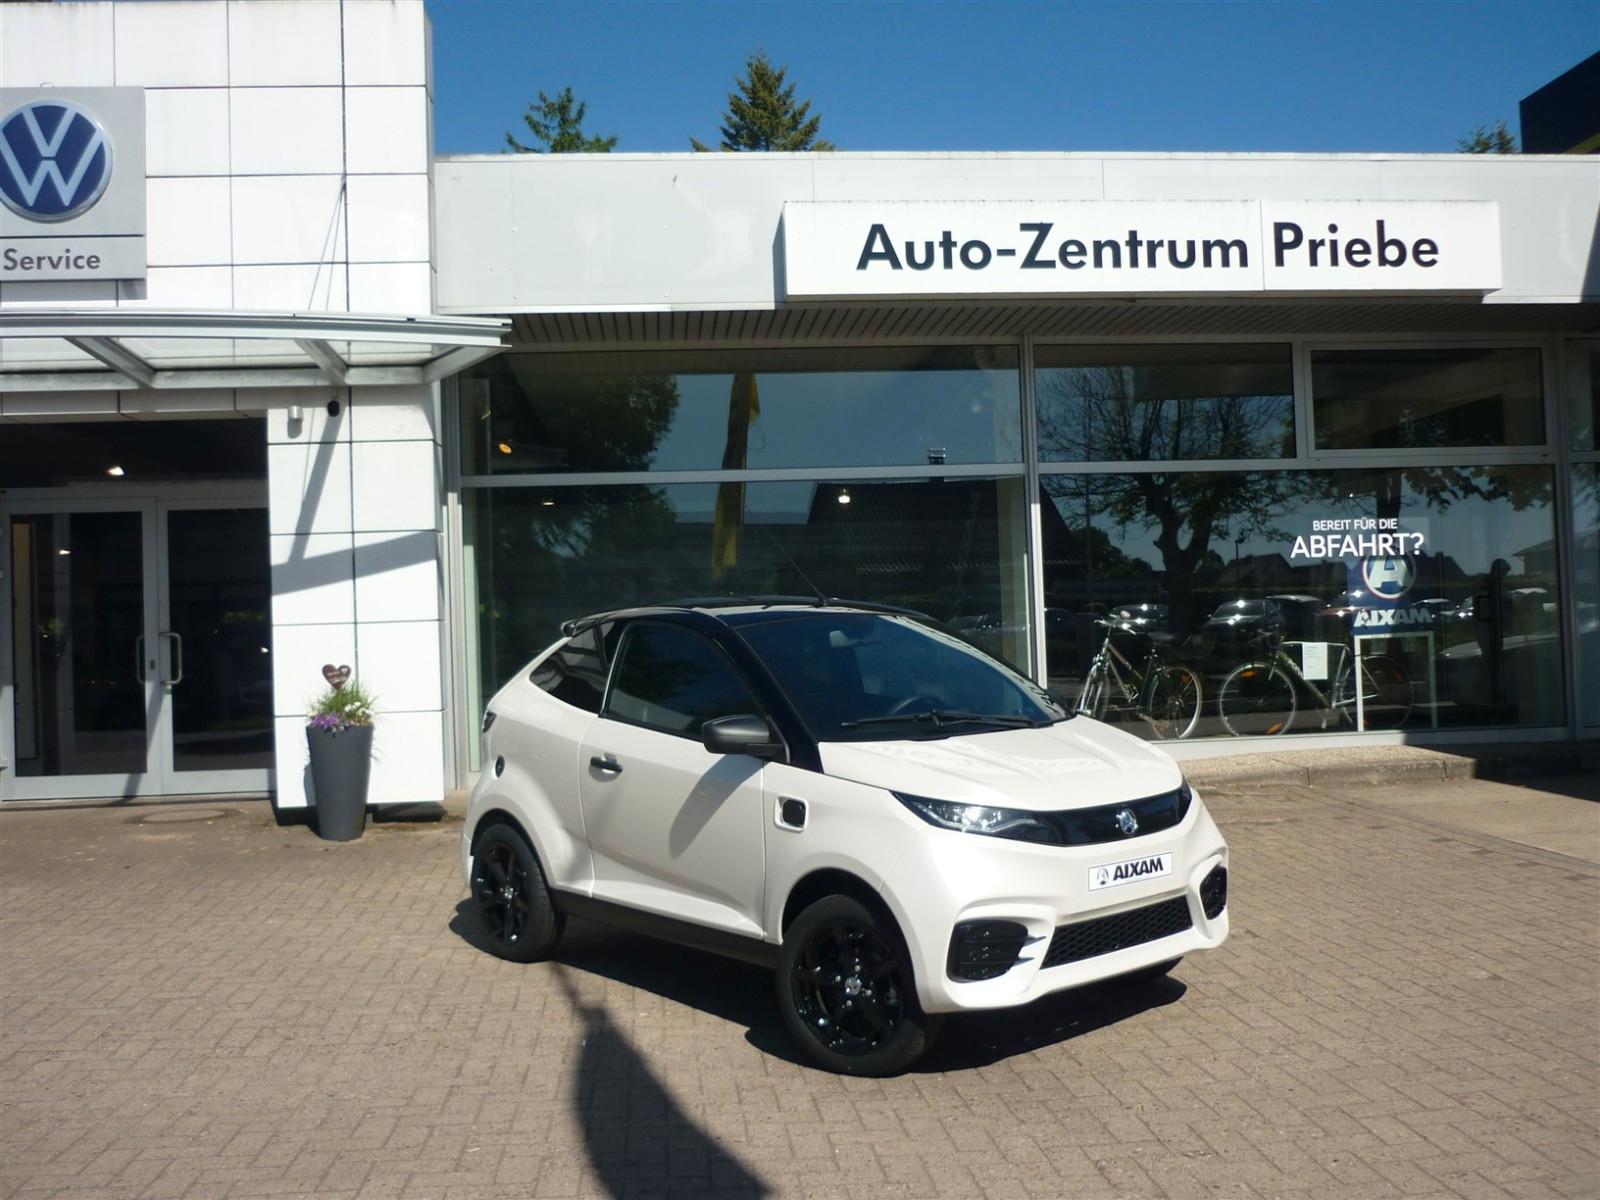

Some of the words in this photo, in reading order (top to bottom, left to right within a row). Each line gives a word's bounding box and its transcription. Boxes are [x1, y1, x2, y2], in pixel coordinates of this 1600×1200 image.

[857, 222, 1249, 271] Auto-Zentrum
[1273, 219, 1439, 269] Priebe
[3, 248, 101, 271] Service
[1312, 520, 1351, 531] BEREIT
[1354, 517, 1376, 530] FÜR
[1379, 518, 1398, 529] DIE
[1290, 533, 1425, 558] ABFAHRT?
[1353, 608, 1432, 627] AIXAM
[1113, 857, 1163, 881] AIXAM
